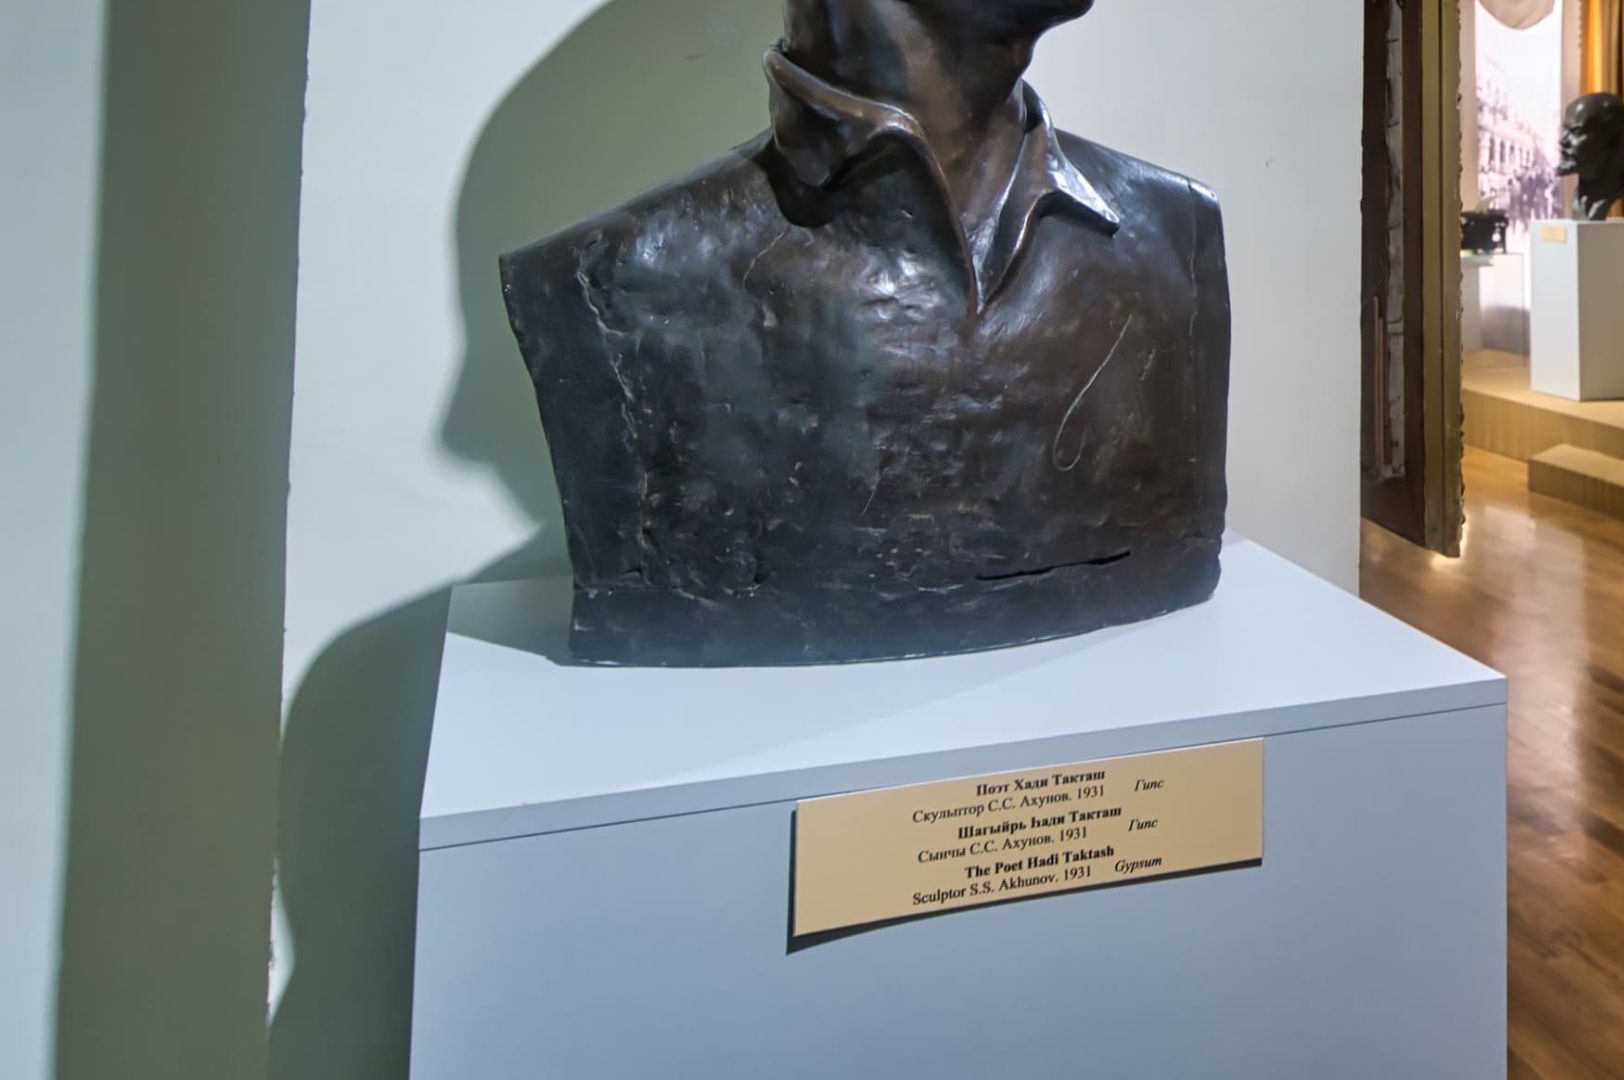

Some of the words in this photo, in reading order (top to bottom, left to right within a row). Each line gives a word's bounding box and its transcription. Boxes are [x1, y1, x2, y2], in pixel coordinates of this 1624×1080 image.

[976, 783, 1010, 797] Поэт
[1014, 777, 1048, 791] Хади
[1052, 771, 1105, 786] Такташ
[1134, 779, 1164, 792] Гипс
[912, 804, 985, 824] Скульптор
[988, 797, 1016, 812] С.С.
[1020, 791, 1072, 808] Ахунов.
[1078, 785, 1104, 799] 1931
[958, 819, 1027, 839] Шагыйрь
[1068, 807, 1122, 822] Такташ
[1128, 818, 1158, 832] Гипс
[918, 847, 966, 863] Сынчы
[970, 840, 998, 855] С.С.
[1002, 835, 1054, 851] Ахунов.
[1059, 826, 1087, 841] 1931
[964, 865, 991, 879] The
[995, 860, 1023, 874] Poet
[1027, 853, 1059, 869] Hadi
[1062, 845, 1114, 863] Taktash
[1114, 857, 1163, 874] Gypsum
[912, 888, 967, 906] Sculptor
[970, 881, 995, 896] S.S.
[999, 874, 1058, 892] Akhunov.
[1064, 865, 1091, 880] 1931
